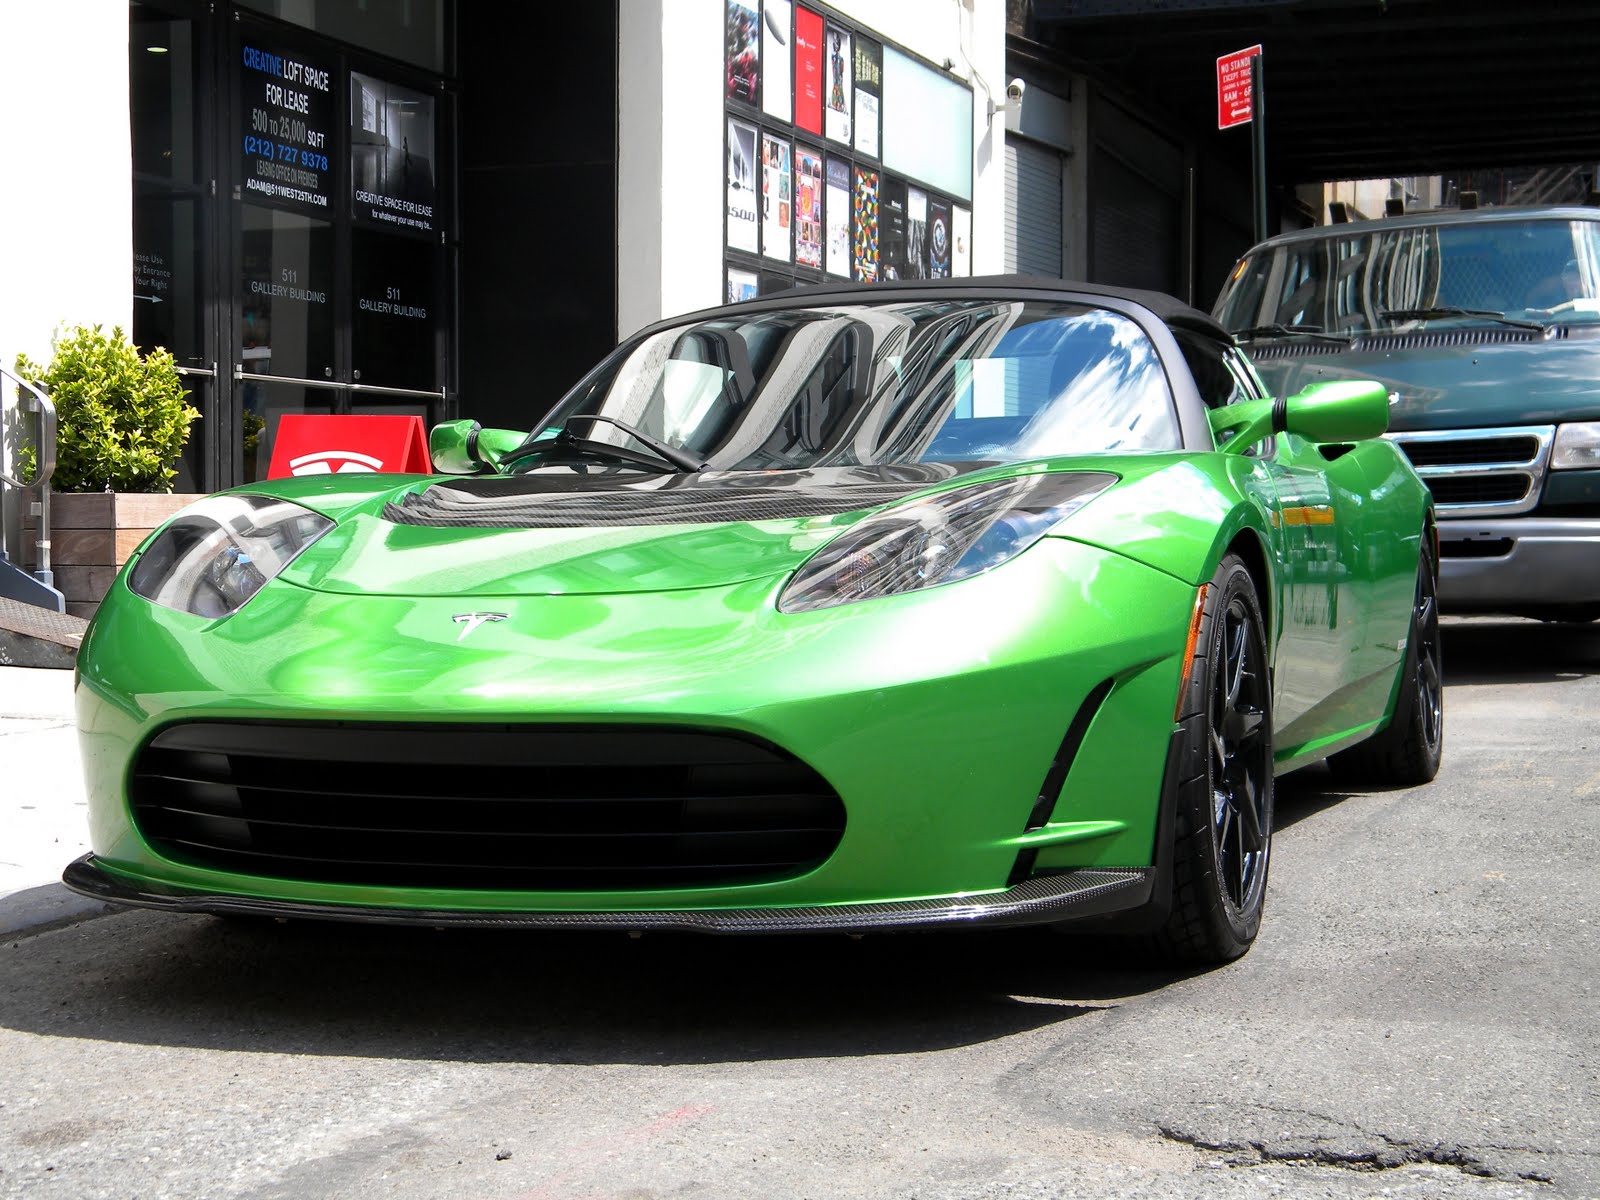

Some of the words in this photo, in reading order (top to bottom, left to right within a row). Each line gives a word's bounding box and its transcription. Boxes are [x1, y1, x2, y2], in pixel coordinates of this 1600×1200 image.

[244, 46, 282, 77] CREATIVE
[283, 59, 303, 83] LOFT
[304, 66, 329, 92] SPACE
[1221, 63, 1229, 74] NO
[1231, 56, 1251, 71] STANDI
[1222, 71, 1239, 83] EXCEPT
[1240, 67, 1252, 78] TRUC
[266, 83, 283, 107] FOR
[283, 88, 309, 114] LEASE
[1223, 90, 1238, 103] 8AM
[252, 108, 268, 133] 500
[280, 116, 306, 143] 25,000
[307, 130, 317, 148] SQ
[317, 132, 325, 149] FT
[244, 135, 275, 161] (212)
[278, 144, 298, 163] 727
[301, 150, 328, 171] 9378
[256, 159, 276, 179] LEASING
[275, 164, 291, 182] OFFICE
[291, 168, 298, 183] ON
[298, 169, 318, 189] PREMISES
[246, 178, 327, 207] ADAM@511WEST25TH.COM
[355, 190, 383, 206] CREATIVE
[383, 196, 402, 211] SPACE
[402, 200, 415, 213] FOR
[415, 203, 433, 217] LEASE
[378, 210, 397, 222] whatever
[397, 216, 407, 226] your
[407, 218, 415, 226] use
[414, 220, 424, 230] may
[135, 253, 150, 263] ease
[151, 254, 164, 265] Use
[143, 265, 171, 278] Entrance
[281, 268, 297, 284] 511
[134, 275, 150, 286] Your
[151, 278, 168, 290] Right
[251, 281, 288, 297] GALLERY
[289, 287, 326, 304] BUILDING
[386, 286, 401, 301] 511
[359, 298, 393, 314] GALLERY
[393, 303, 426, 319] BUILDING
